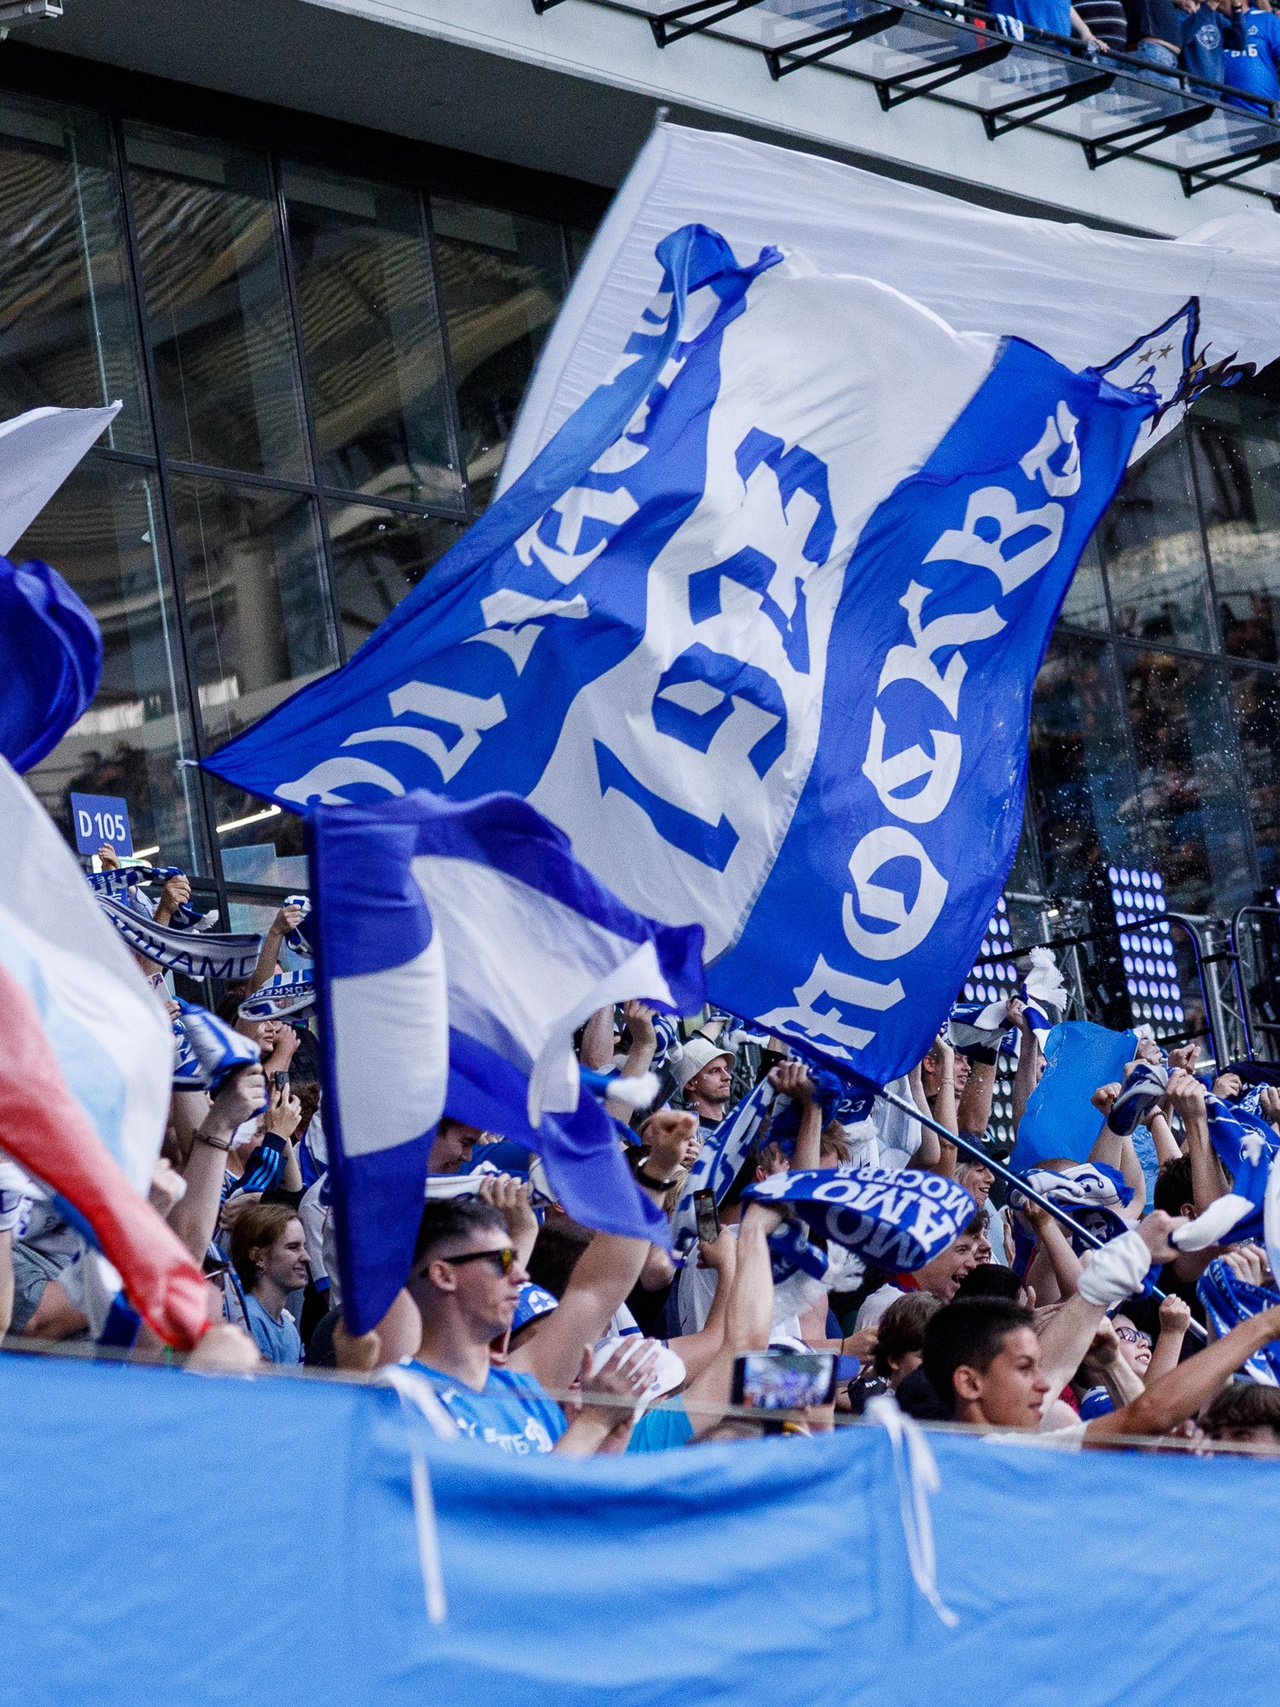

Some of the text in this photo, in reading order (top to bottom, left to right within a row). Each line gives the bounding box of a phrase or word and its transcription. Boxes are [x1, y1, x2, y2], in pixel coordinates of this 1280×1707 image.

[594, 427, 837, 873] 1923
[78, 809, 126, 842] D 105
[833, 1166, 975, 1228] МОСКВА
